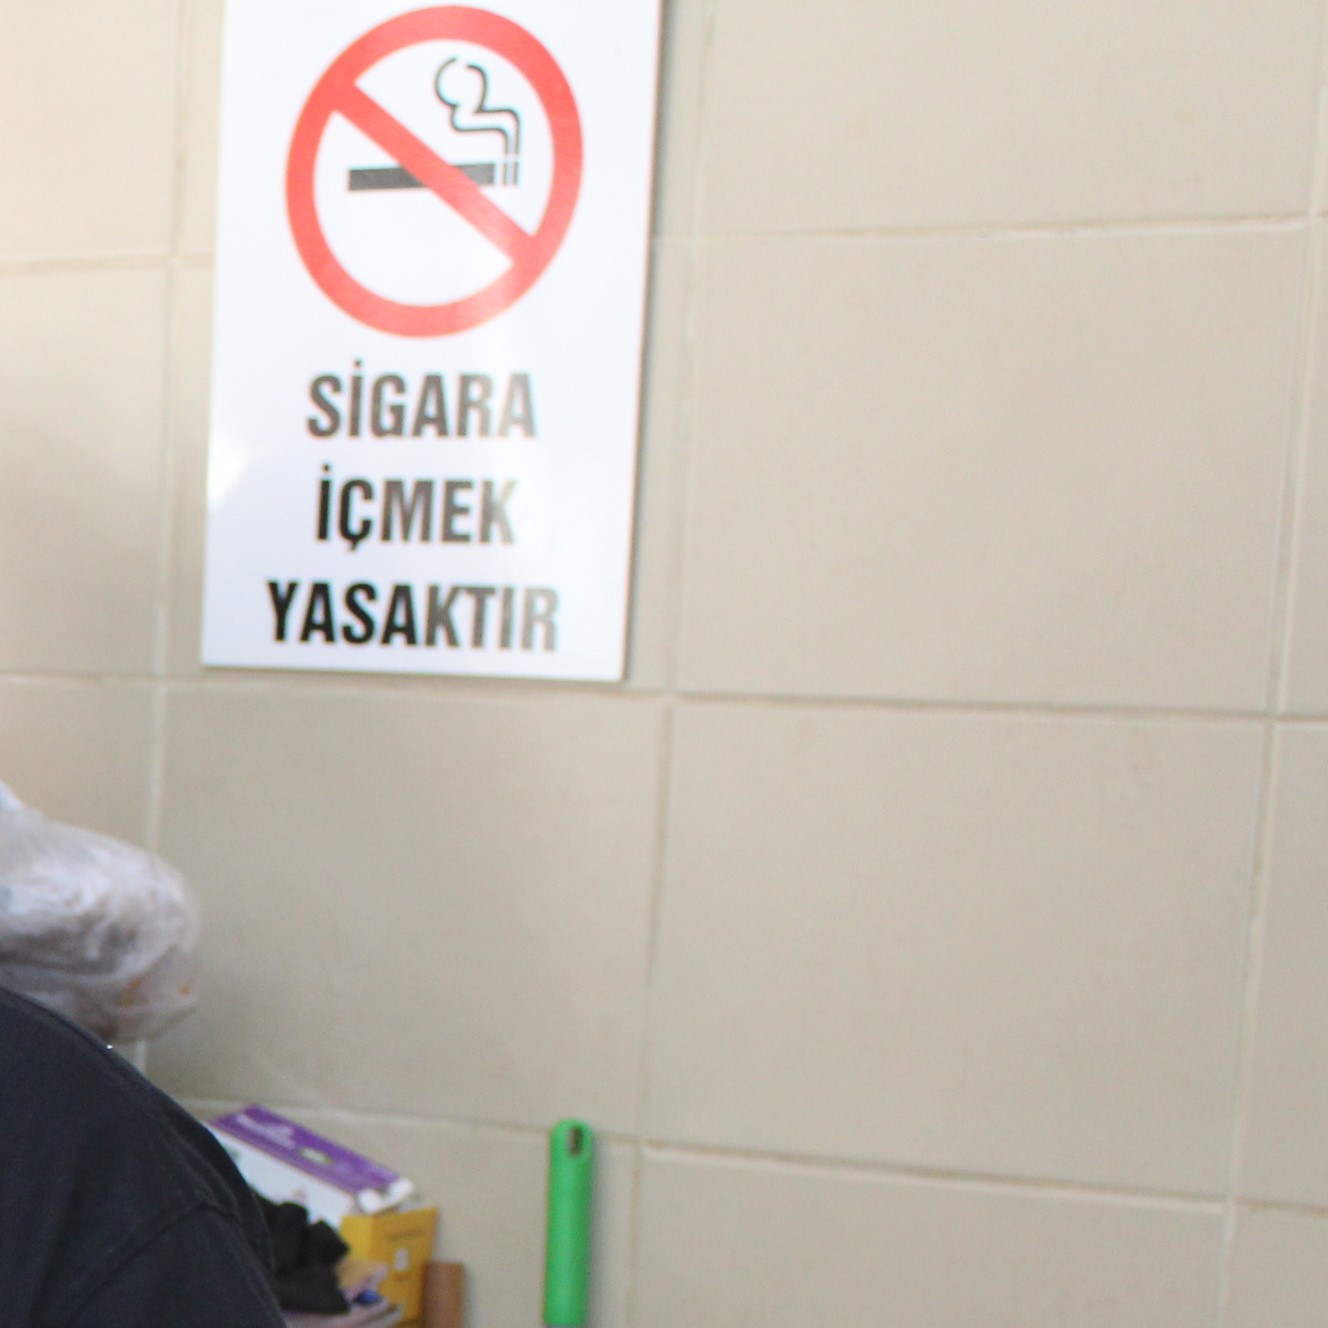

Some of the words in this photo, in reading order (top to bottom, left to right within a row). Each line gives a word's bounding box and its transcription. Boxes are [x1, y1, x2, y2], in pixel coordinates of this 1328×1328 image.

[305, 359, 537, 439] SİGARA
[315, 464, 519, 552] İÇMEK
[266, 579, 561, 653] YASAKTIR
